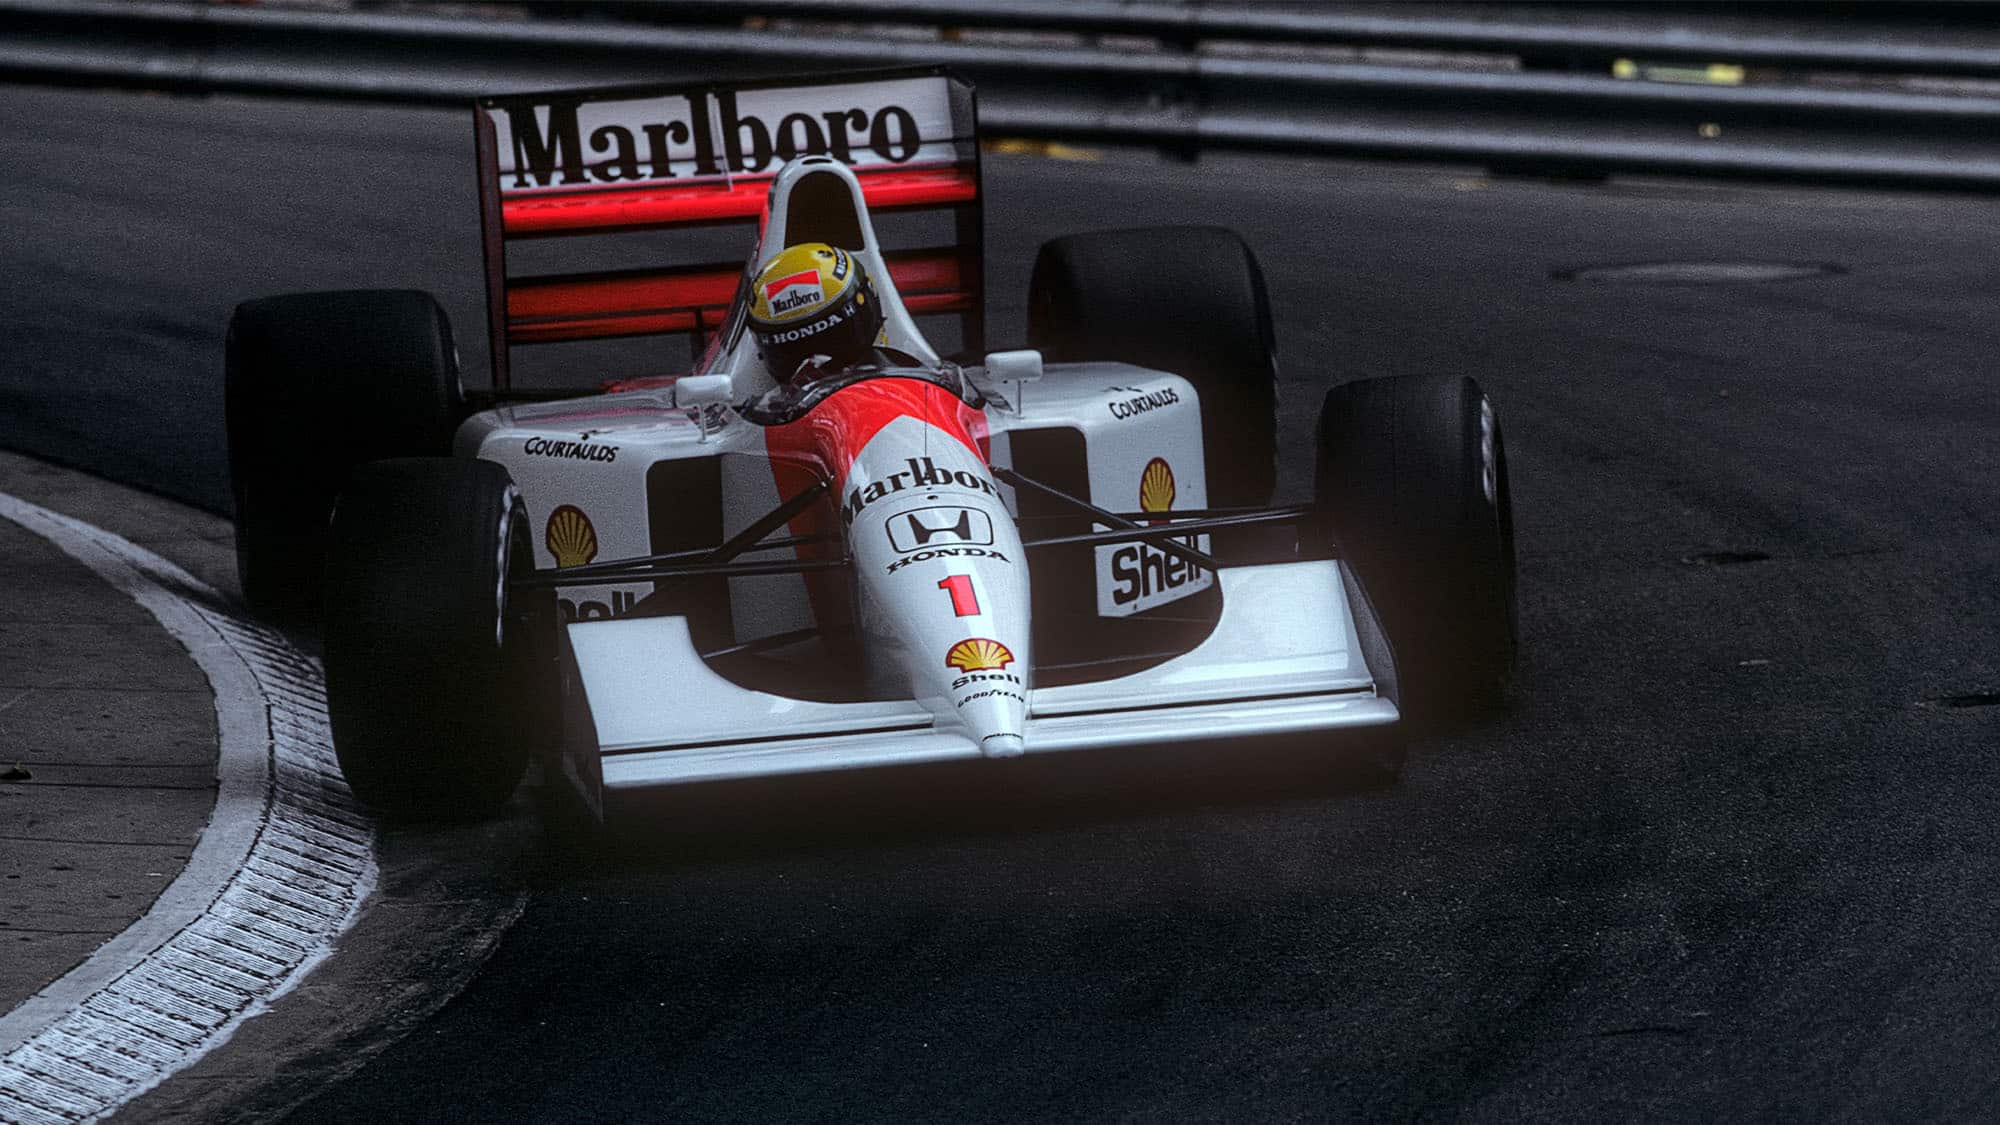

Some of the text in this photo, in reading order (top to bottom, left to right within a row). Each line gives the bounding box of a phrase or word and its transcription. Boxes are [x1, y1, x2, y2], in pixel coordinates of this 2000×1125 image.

[506, 88, 920, 188] Marlboro
[771, 290, 821, 315] Marlboro
[773, 314, 843, 344] HONDA
[1109, 387, 1180, 420] COURTAULDS
[524, 436, 620, 463] COURTAULDS
[839, 457, 1010, 528] Marlbor
[886, 548, 1011, 575] HONDA
[1112, 534, 1201, 606] Shell
[937, 574, 981, 617] 1
[951, 673, 1021, 690] Shell
